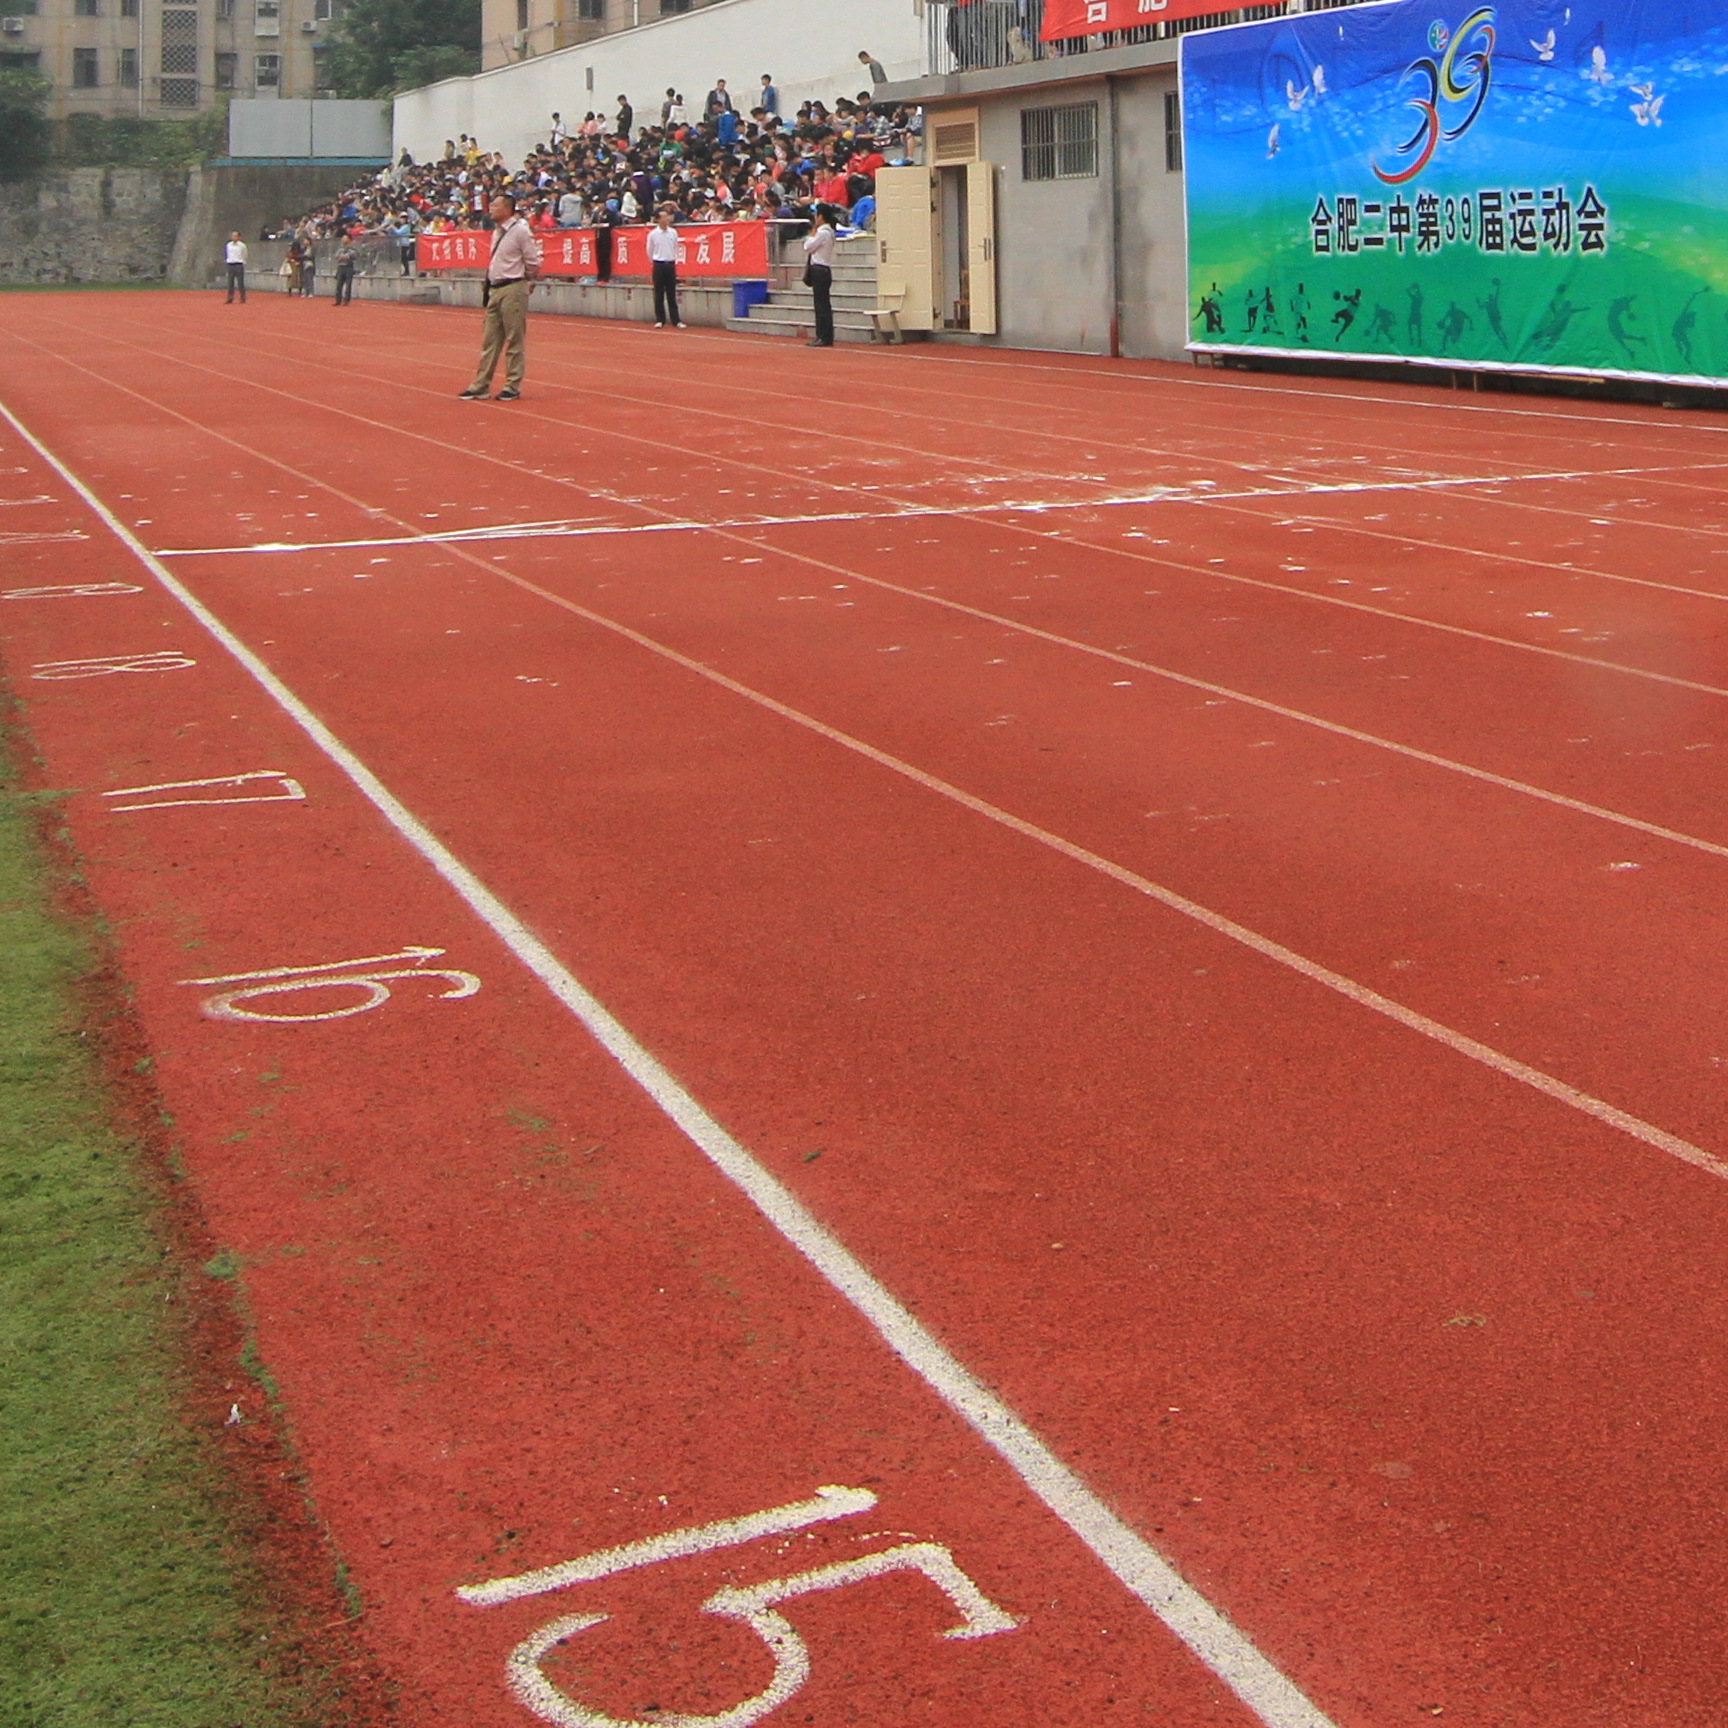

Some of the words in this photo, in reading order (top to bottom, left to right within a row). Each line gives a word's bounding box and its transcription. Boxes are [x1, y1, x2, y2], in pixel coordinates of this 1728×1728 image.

[1311, 185, 1606, 254] 合肥二中第39届运动会
[32, 651, 197, 680] 18
[102, 770, 306, 812] 17
[175, 945, 481, 1023] 16
[456, 1484, 1026, 1728] 15
